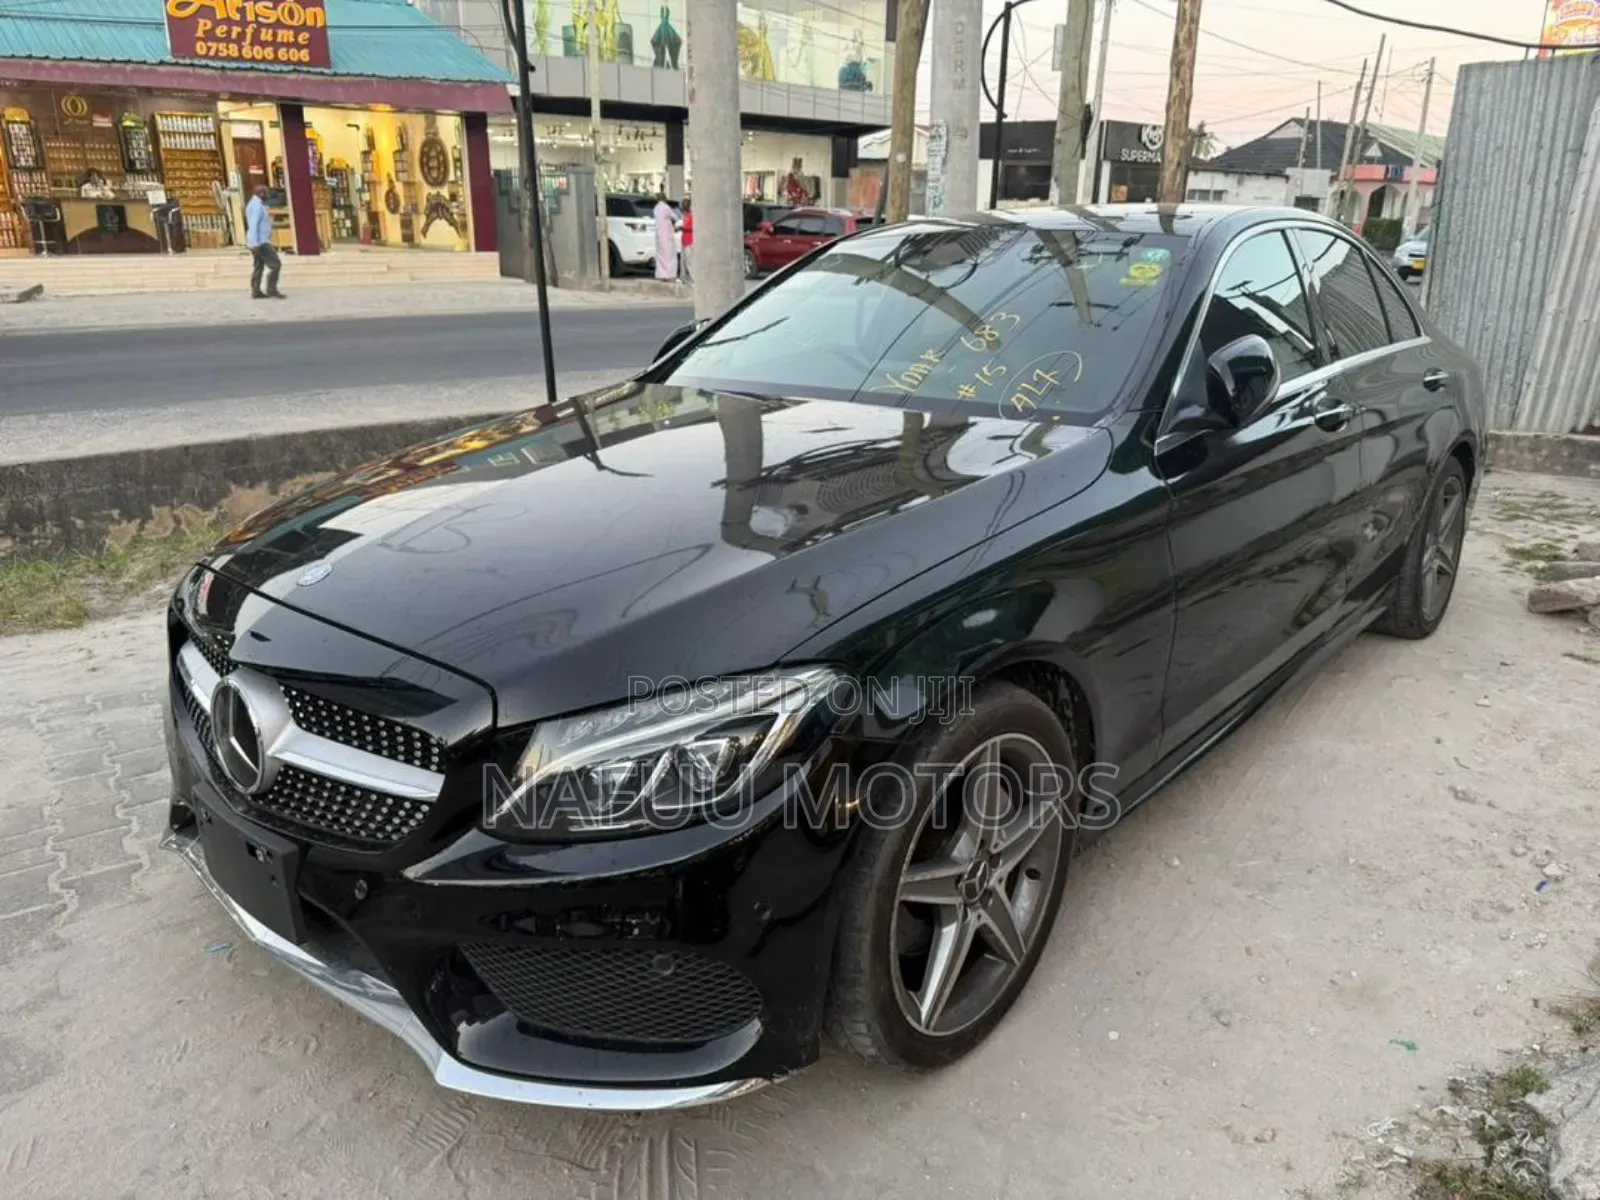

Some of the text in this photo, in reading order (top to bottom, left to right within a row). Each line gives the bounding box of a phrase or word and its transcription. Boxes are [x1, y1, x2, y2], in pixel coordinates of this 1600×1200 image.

[195, 18, 310, 45] Perfume
[196, 41, 310, 62] 0758 606 606
